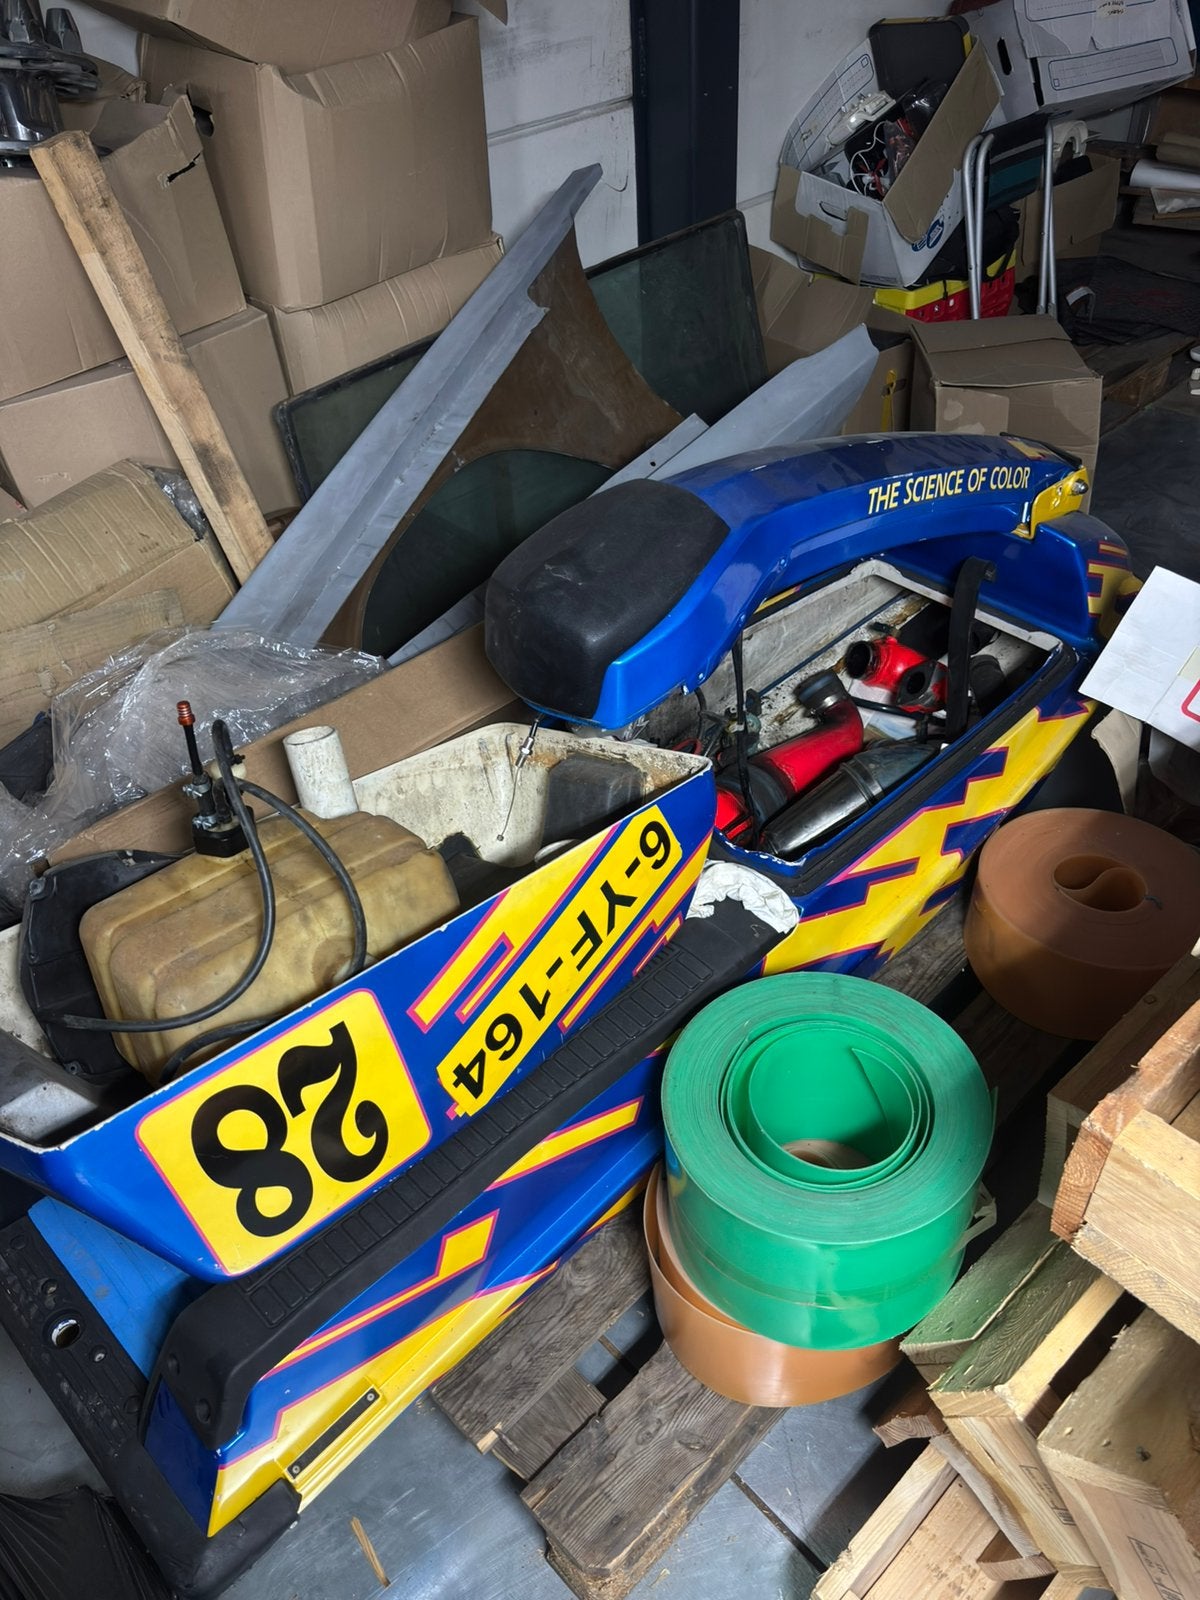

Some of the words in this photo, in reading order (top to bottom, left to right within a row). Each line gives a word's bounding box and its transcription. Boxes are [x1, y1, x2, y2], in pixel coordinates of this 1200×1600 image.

[868, 481, 901, 515] THE
[903, 469, 965, 505] SCIENCE
[967, 468, 988, 493] OF
[990, 466, 1031, 490] COLOR
[452, 820, 672, 1100] 6-YF-164
[191, 1020, 389, 1238] 28
